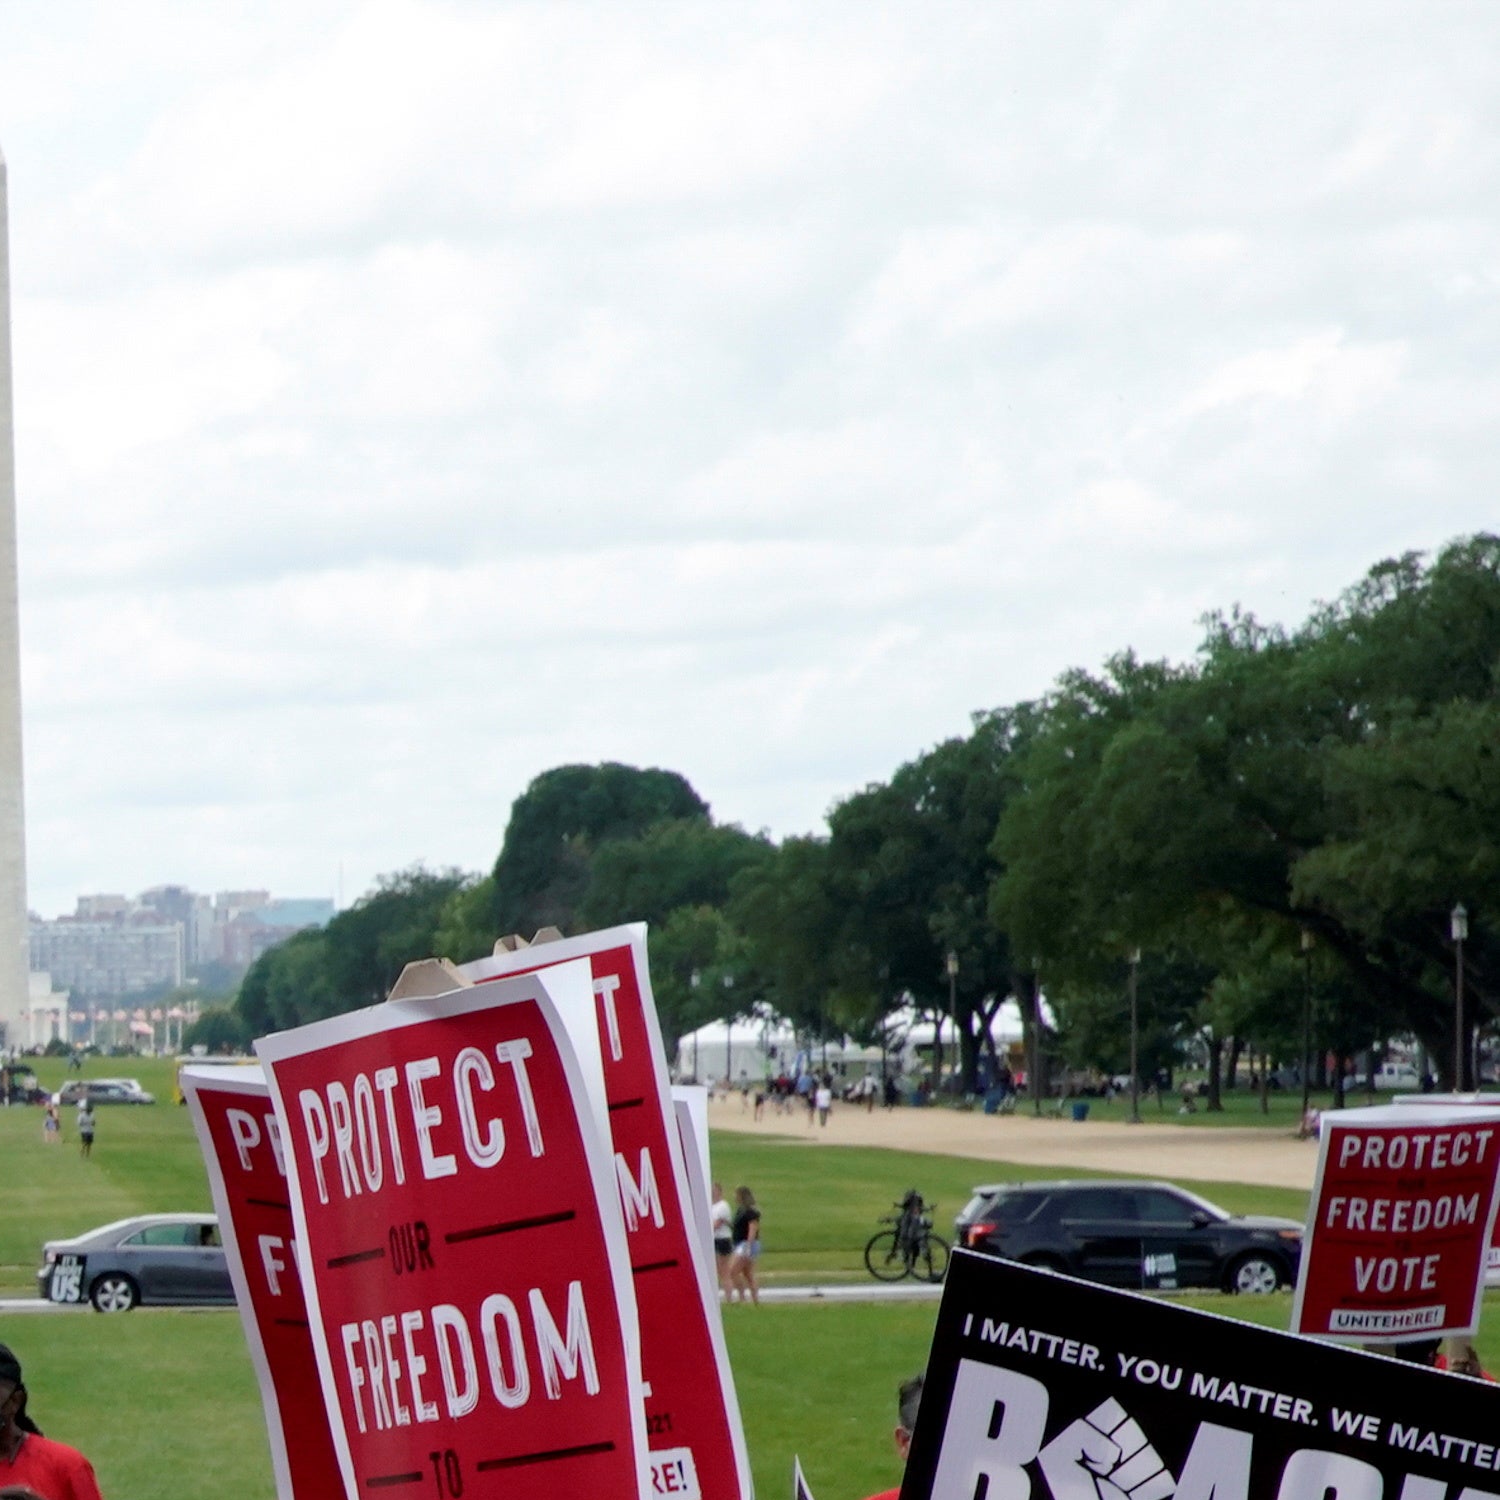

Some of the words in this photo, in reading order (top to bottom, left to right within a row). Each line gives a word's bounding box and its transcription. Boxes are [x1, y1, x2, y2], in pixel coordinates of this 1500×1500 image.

[298, 1037, 545, 1206] PROTECT
[1339, 1130, 1494, 1170] PROTECT
[1326, 1193, 1480, 1232] FREEDOM
[389, 1220, 437, 1276] OUR
[1354, 1254, 1441, 1293] VOTE
[341, 1281, 600, 1434] FREEDOM
[962, 1313, 975, 1337] I
[981, 1321, 1106, 1373] MATTER.
[1116, 1355, 1182, 1392] YOU
[1189, 1371, 1319, 1427] MATTER.
[1331, 1407, 1382, 1441] WE
[429, 1449, 464, 1500] TO
